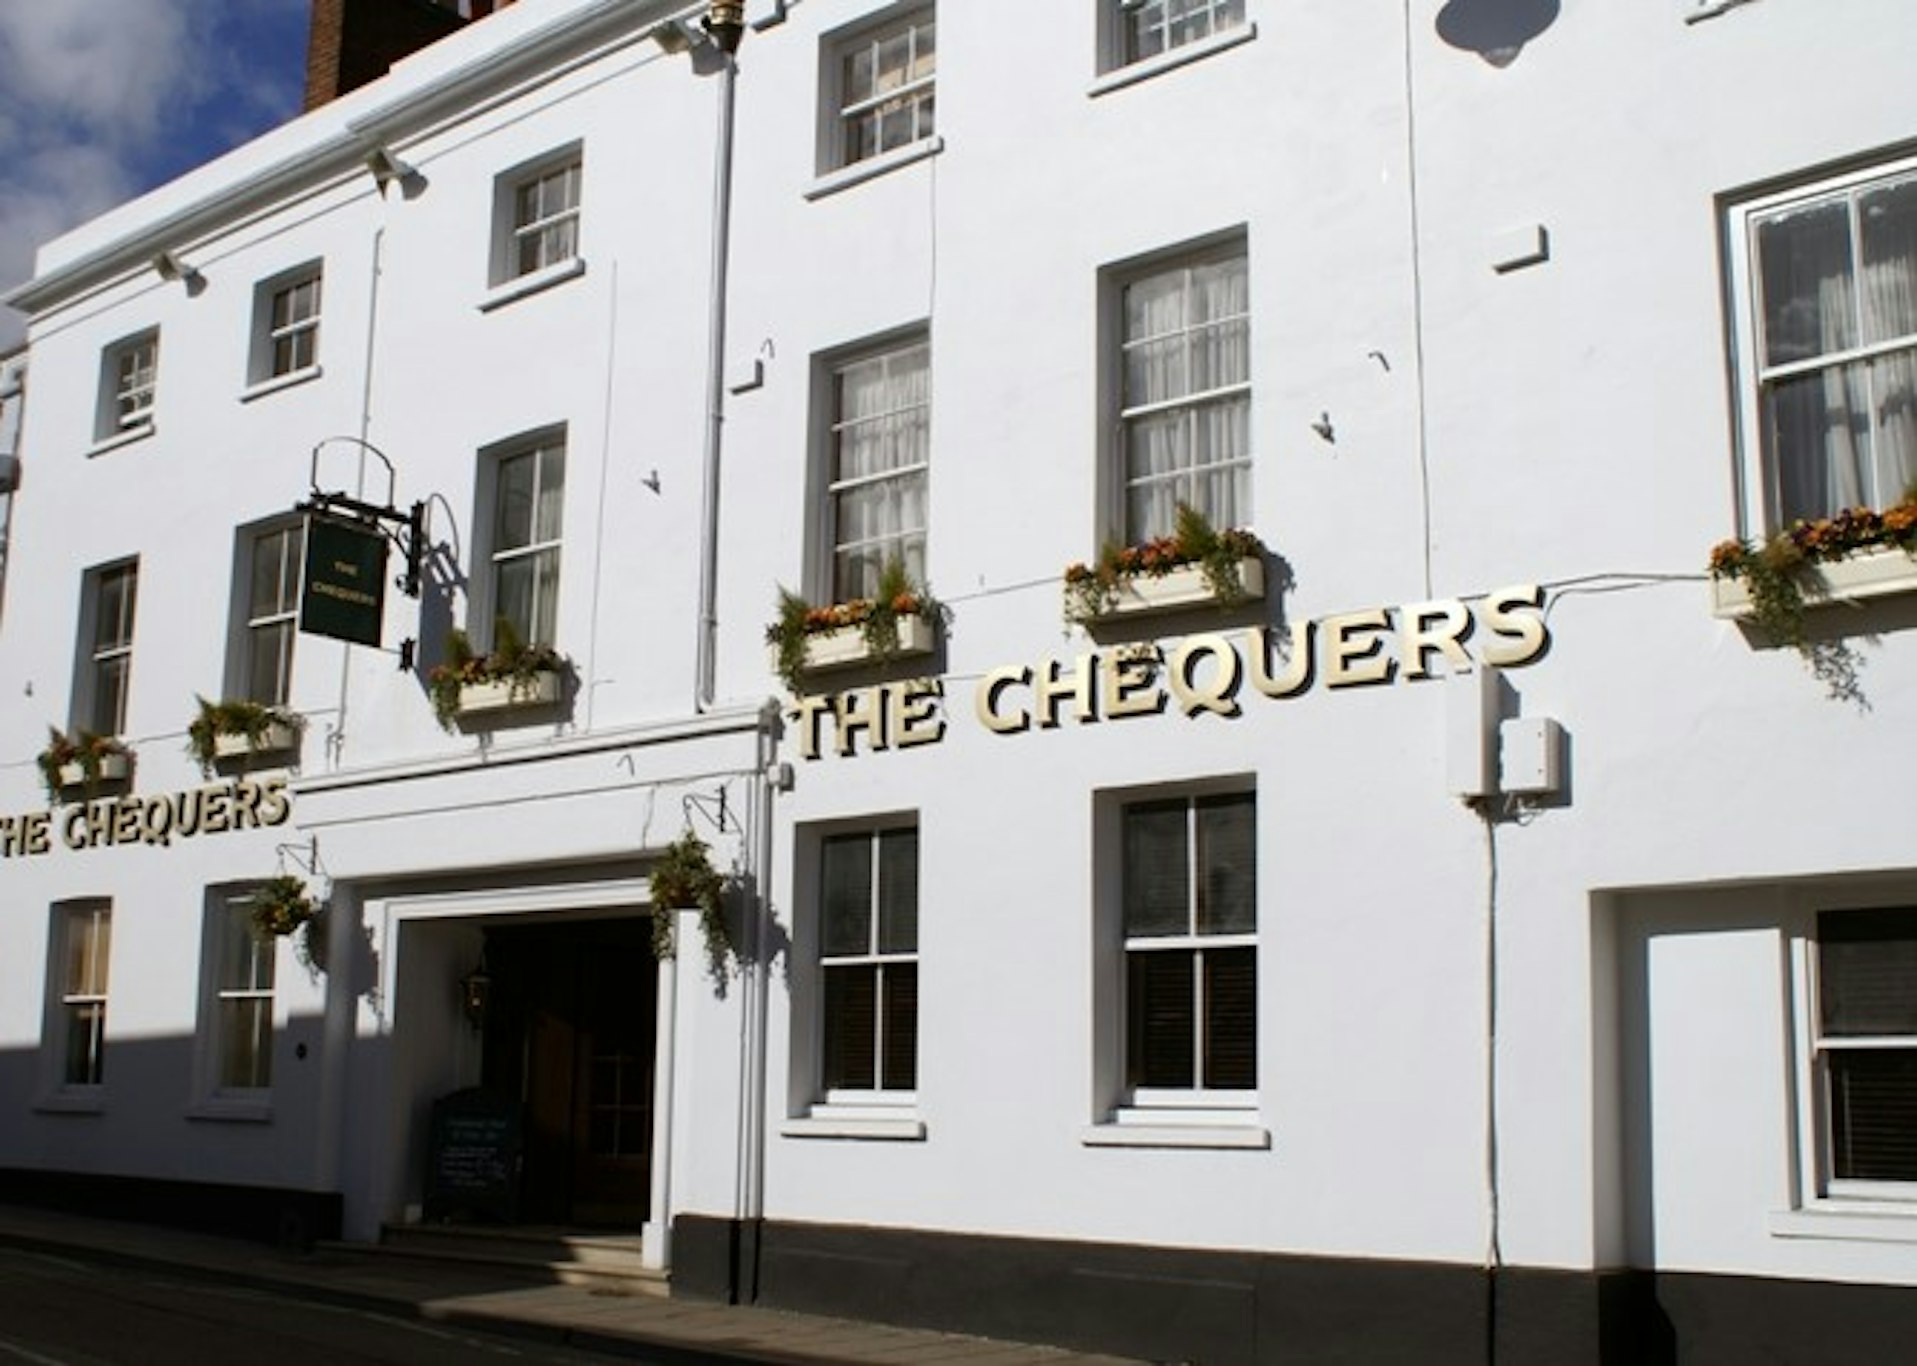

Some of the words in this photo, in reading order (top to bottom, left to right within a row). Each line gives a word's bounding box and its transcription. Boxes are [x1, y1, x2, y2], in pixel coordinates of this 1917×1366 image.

[783, 676, 947, 760] THE
[974, 583, 1550, 733] CHEQUERS
[0, 810, 52, 858] HE
[61, 776, 291, 850] CHEQUERS
